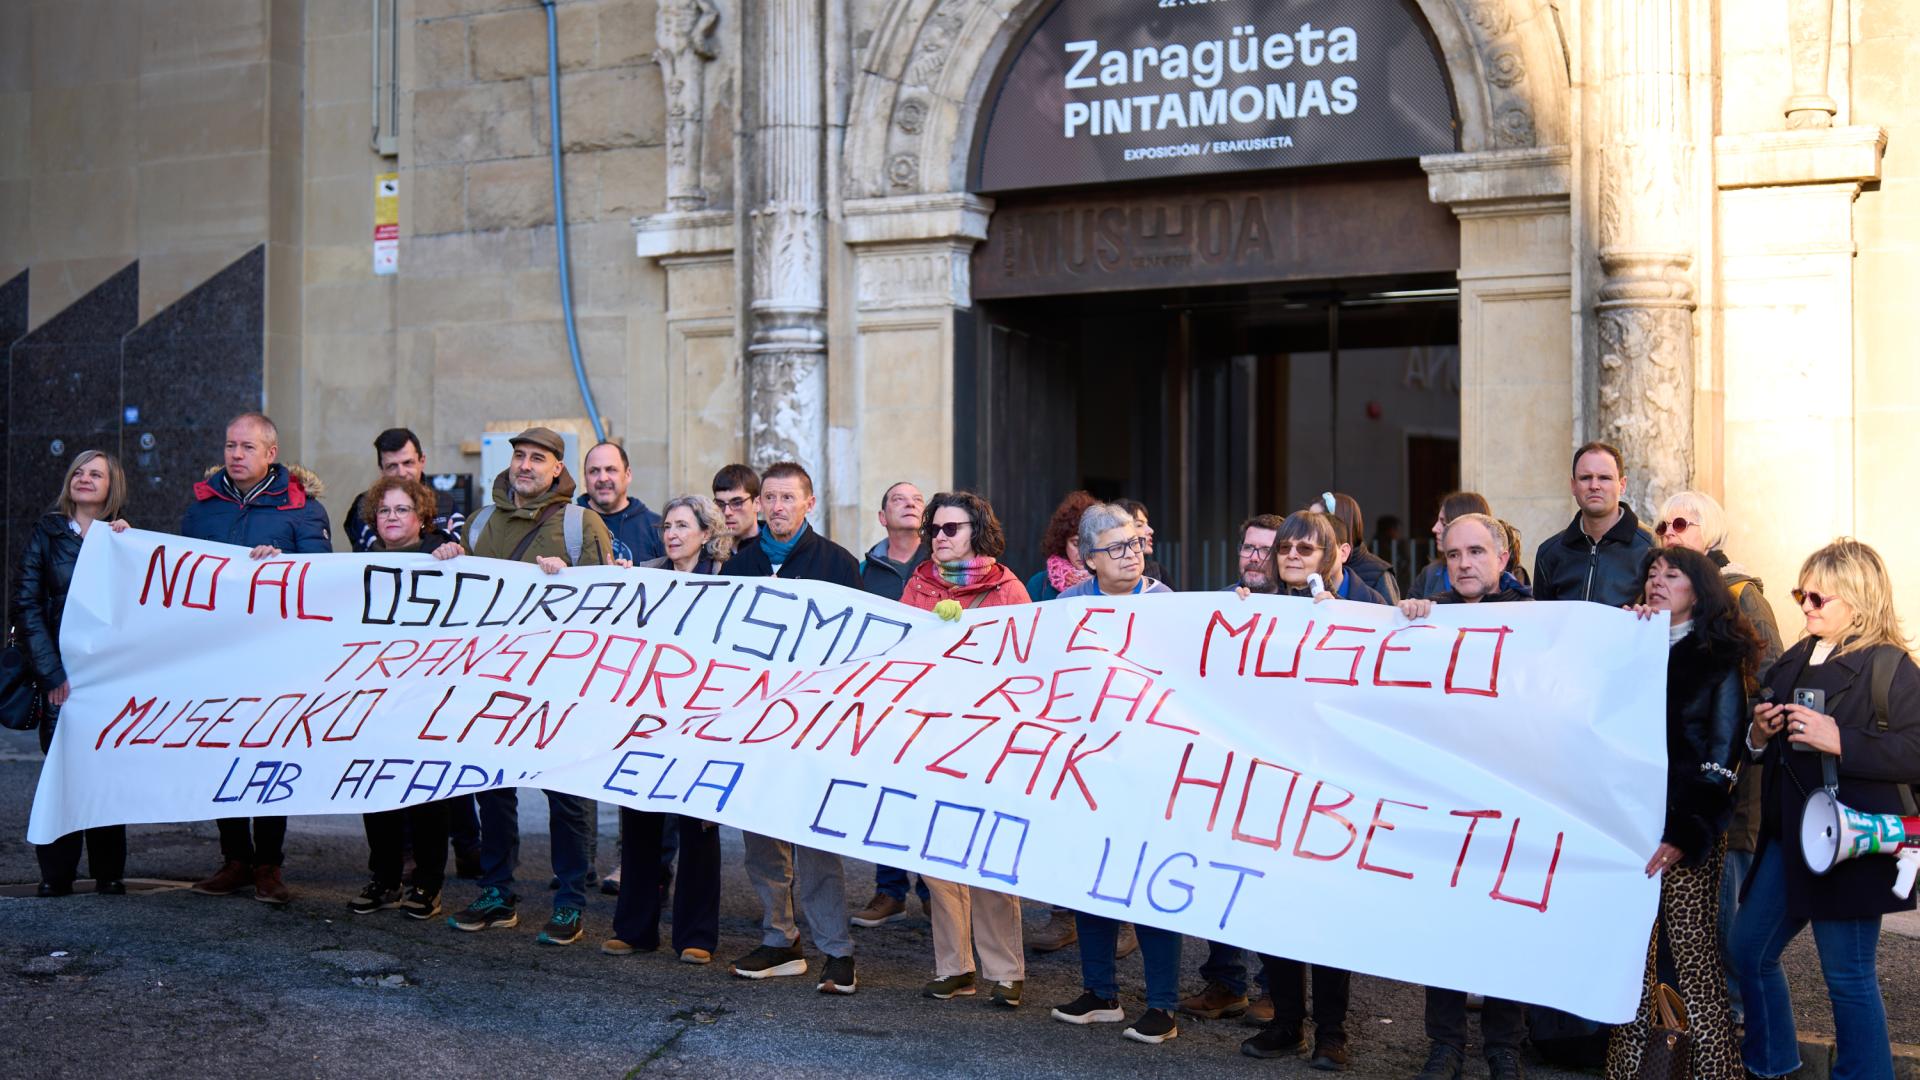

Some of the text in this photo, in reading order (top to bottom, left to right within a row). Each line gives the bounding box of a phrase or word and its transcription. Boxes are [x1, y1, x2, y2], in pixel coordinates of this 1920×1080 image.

[1064, 23, 1358, 89] Zaragüeta
[1064, 76, 1358, 138] PINTAMONAS
[1124, 143, 1200, 161] EXPOSICIÓN
[1213, 135, 1294, 153] ERAKUSKETA
[140, 544, 1514, 697] NO AL OSCURANTISMO EN EL MUSEO
[974, 666, 1200, 734] REAL
[95, 688, 388, 750] MUSEOKO
[418, 685, 578, 750] LAN
[1164, 743, 1564, 912] HOBETU
[212, 756, 303, 804] LAB
[603, 750, 744, 812] ELA
[809, 778, 1031, 886] CCOO
[1088, 838, 1266, 929] UGT
